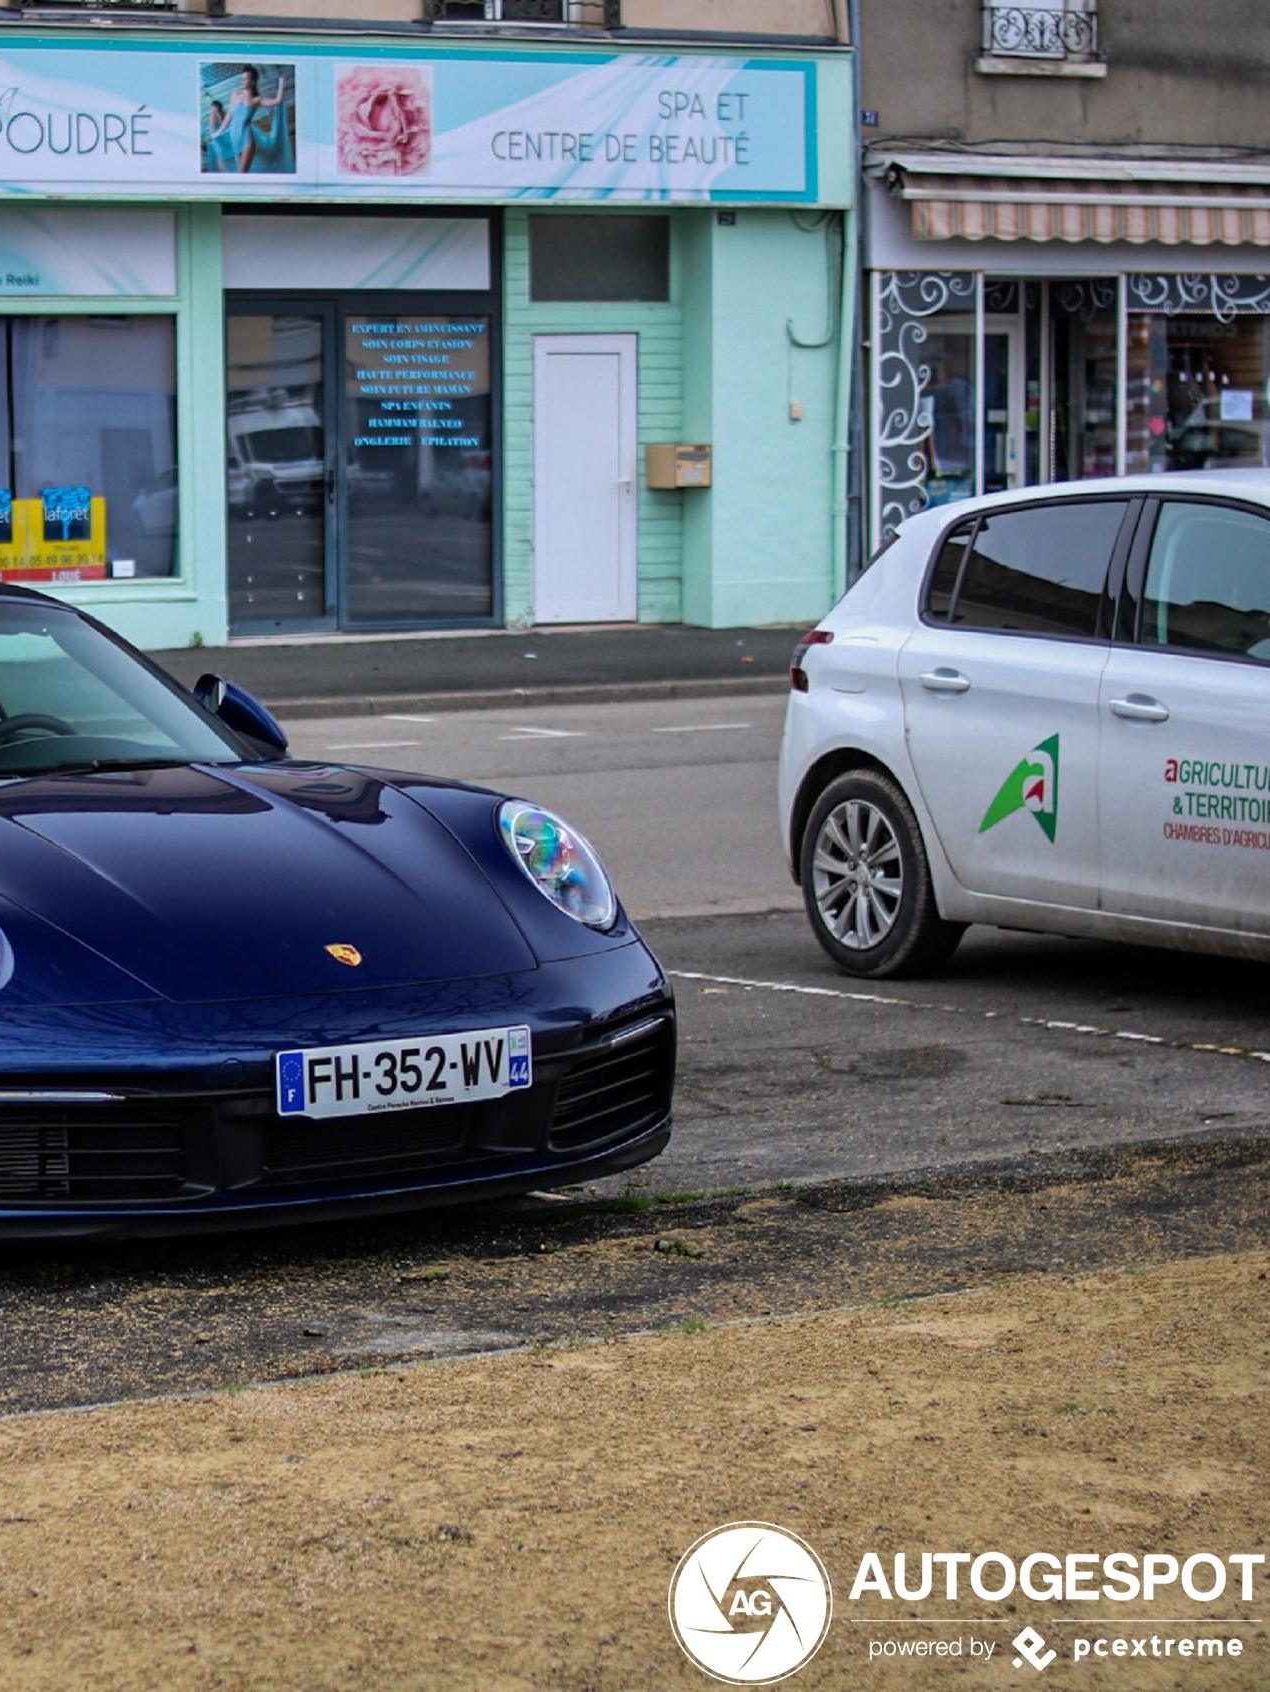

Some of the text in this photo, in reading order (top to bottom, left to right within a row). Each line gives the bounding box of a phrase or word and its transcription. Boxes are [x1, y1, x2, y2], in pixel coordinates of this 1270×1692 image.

[658, 90, 750, 121] SPA ET
[491, 130, 751, 166] CENTRE DE BEAUTÉ
[6, 274, 40, 287] Reiki
[351, 324, 485, 334] EXPERT EN AMINCISSANT
[362, 340, 472, 348] SOIN CORPS EVASION
[382, 355, 449, 364] SOIN VISAGE
[356, 370, 475, 380] HAUTE PERFORMANCE
[359, 385, 472, 394] SOIN FUTURE MAMAN
[380, 401, 452, 410] SPA ENFANTS
[368, 418, 462, 429] HAMMAM BALNEO
[354, 436, 479, 447] ONGLERIE EPILATION
[44, 506, 89, 522] laforêt
[30, 555, 42, 566] 05
[46, 554, 58, 565] 49
[1164, 759, 1270, 791] aGRICULTU
[1173, 797, 1183, 815] &
[1163, 822, 1221, 844] CHAMBRES
[308, 1039, 504, 1104] FH-352-WV
[510, 1062, 527, 1082] 44
